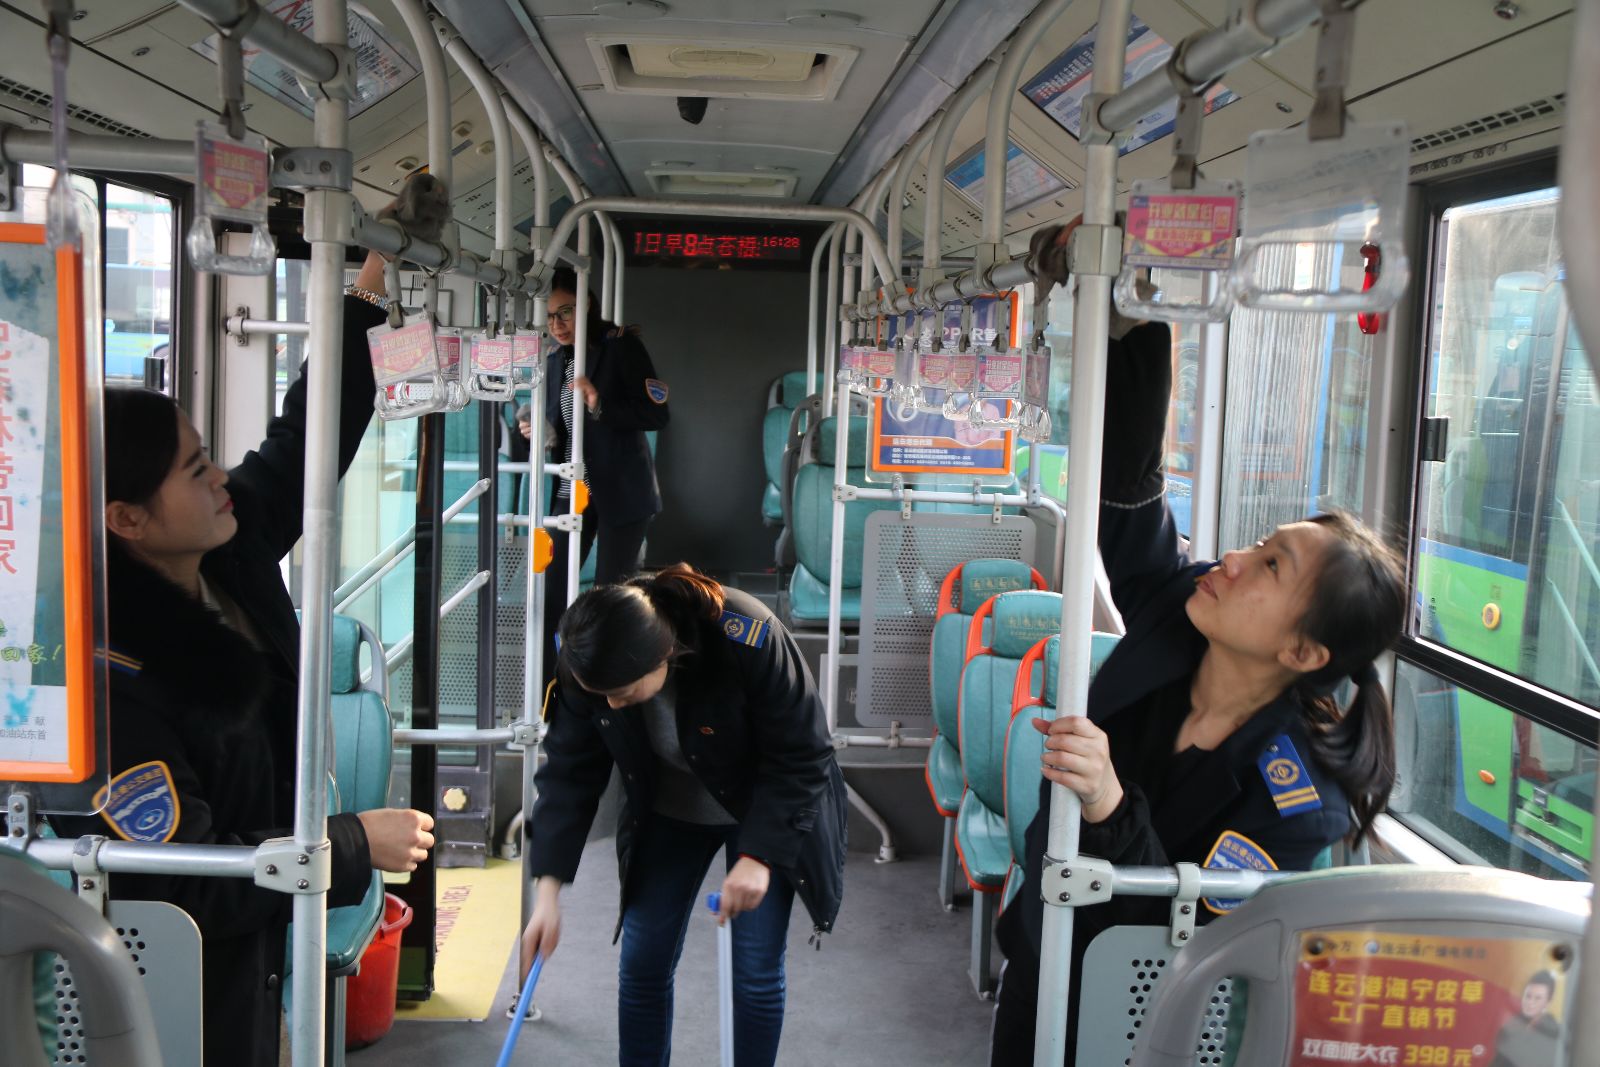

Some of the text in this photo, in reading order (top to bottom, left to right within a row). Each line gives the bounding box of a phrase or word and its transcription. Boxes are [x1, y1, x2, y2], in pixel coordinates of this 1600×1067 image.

[763, 236, 800, 248] 16:28
[1308, 969, 1485, 1003] 连云港海宁皮草
[1329, 1000, 1456, 1029] 工厂直销节
